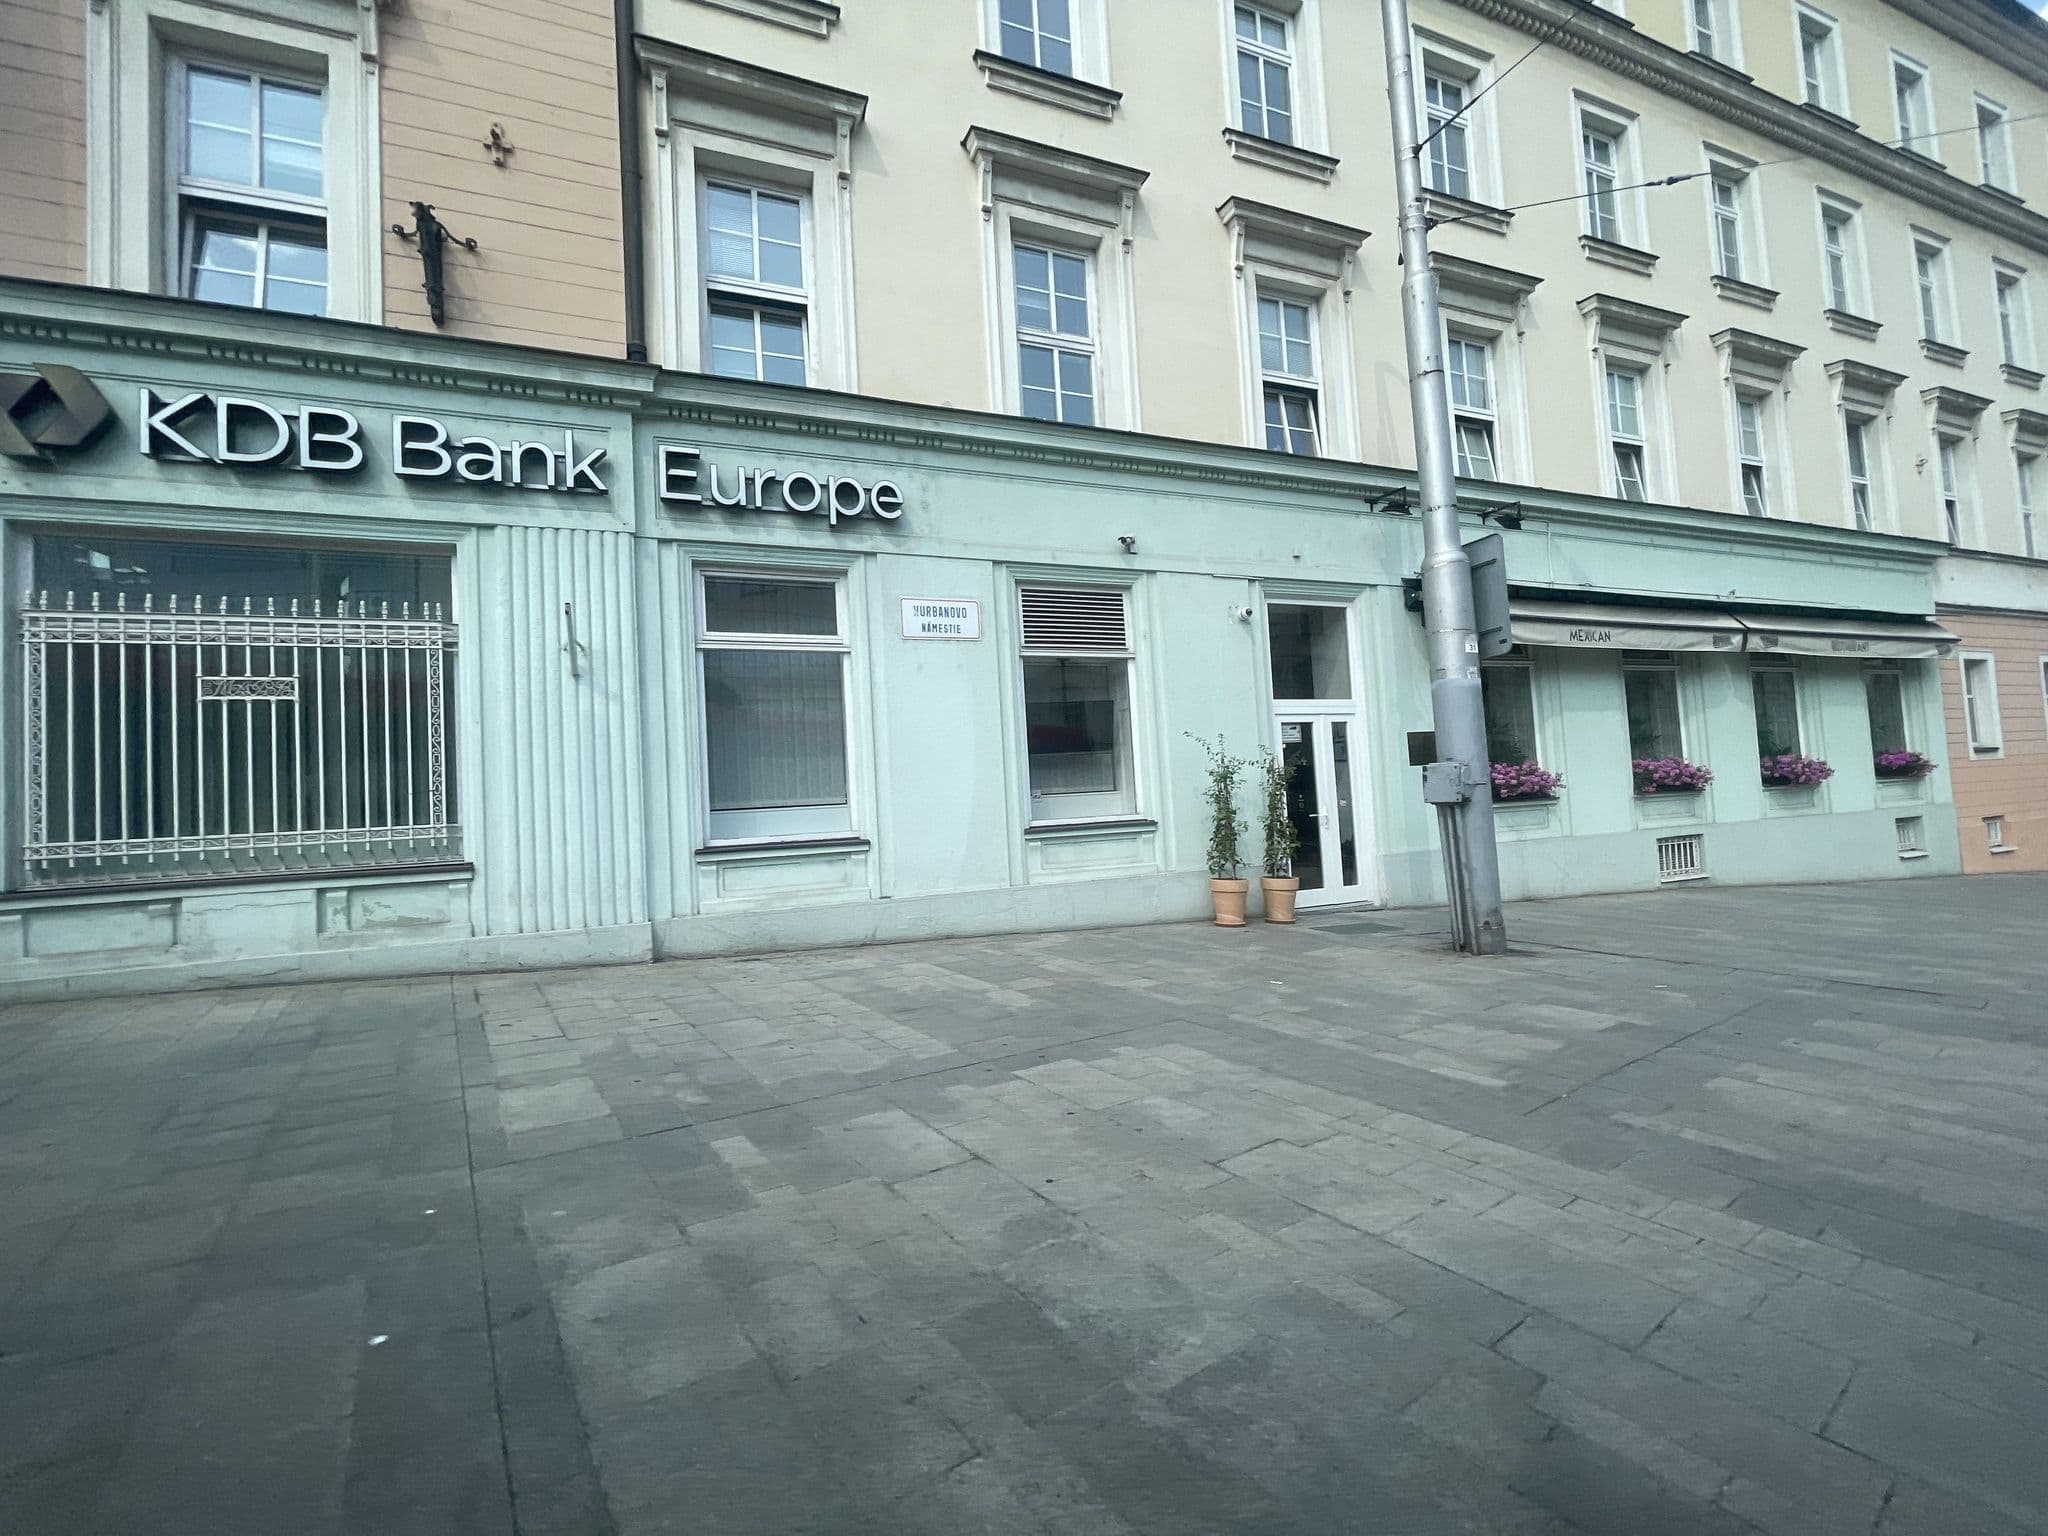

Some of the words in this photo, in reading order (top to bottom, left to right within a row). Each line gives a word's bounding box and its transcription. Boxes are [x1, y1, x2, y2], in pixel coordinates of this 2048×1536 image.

[138, 387, 364, 471] KDB
[392, 414, 608, 495] Bank
[658, 444, 904, 526] Europe
[913, 605, 967, 618] HURBANOVO
[921, 621, 962, 634] NÁMESTIE
